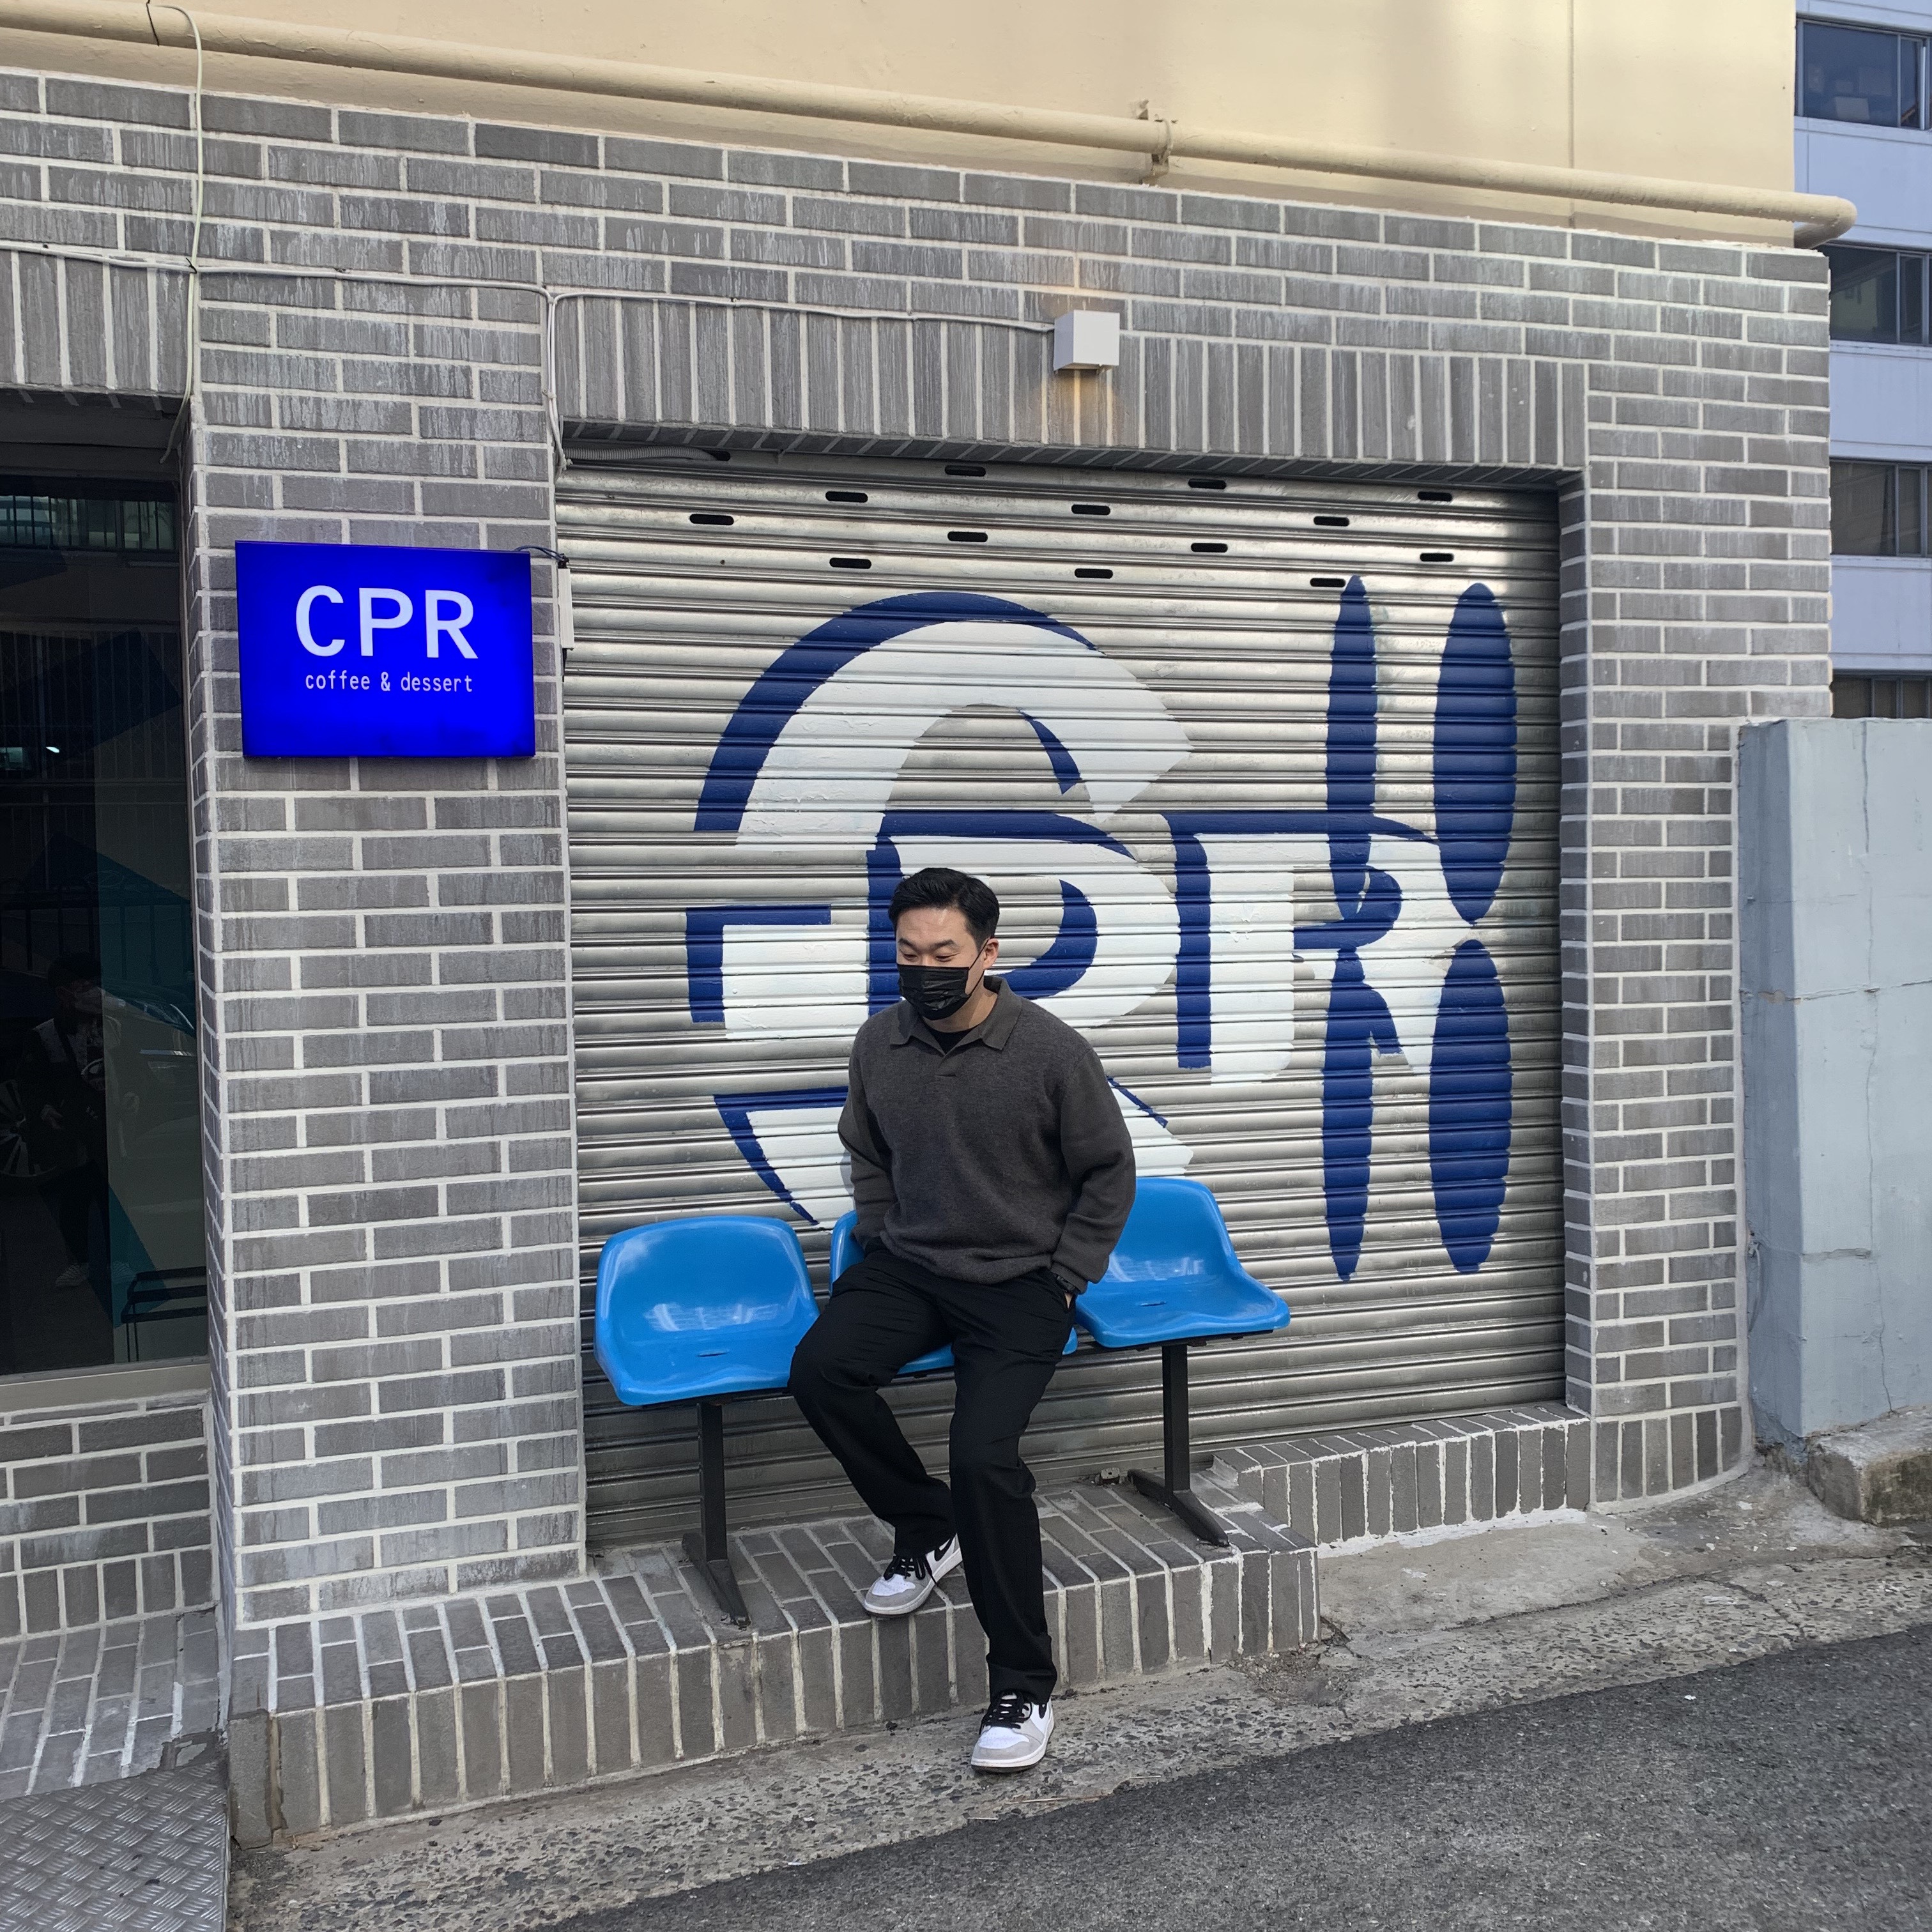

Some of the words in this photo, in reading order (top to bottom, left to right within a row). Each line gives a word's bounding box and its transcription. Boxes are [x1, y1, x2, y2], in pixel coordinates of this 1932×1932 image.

[295, 585, 479, 659] CPR
[305, 670, 371, 690] coffee
[380, 671, 390, 692] &
[401, 671, 472, 693] dessert
